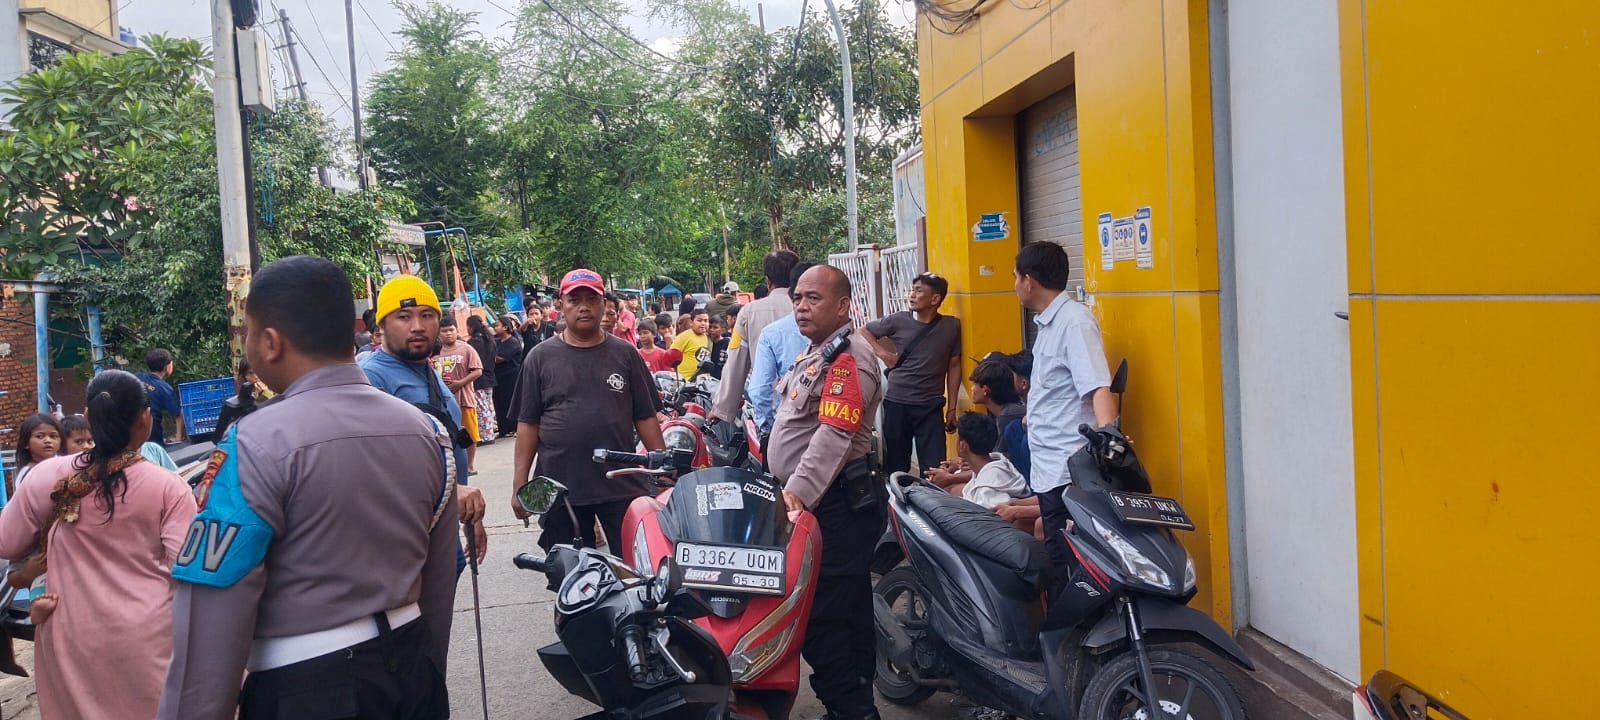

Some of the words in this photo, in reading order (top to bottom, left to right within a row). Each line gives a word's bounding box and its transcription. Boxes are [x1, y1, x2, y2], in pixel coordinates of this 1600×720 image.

[1114, 495, 1125, 507] B
[1126, 497, 1153, 509] 3957
[682, 547, 690, 563] B
[698, 549, 736, 566] 3364
[747, 552, 778, 571] UQM
